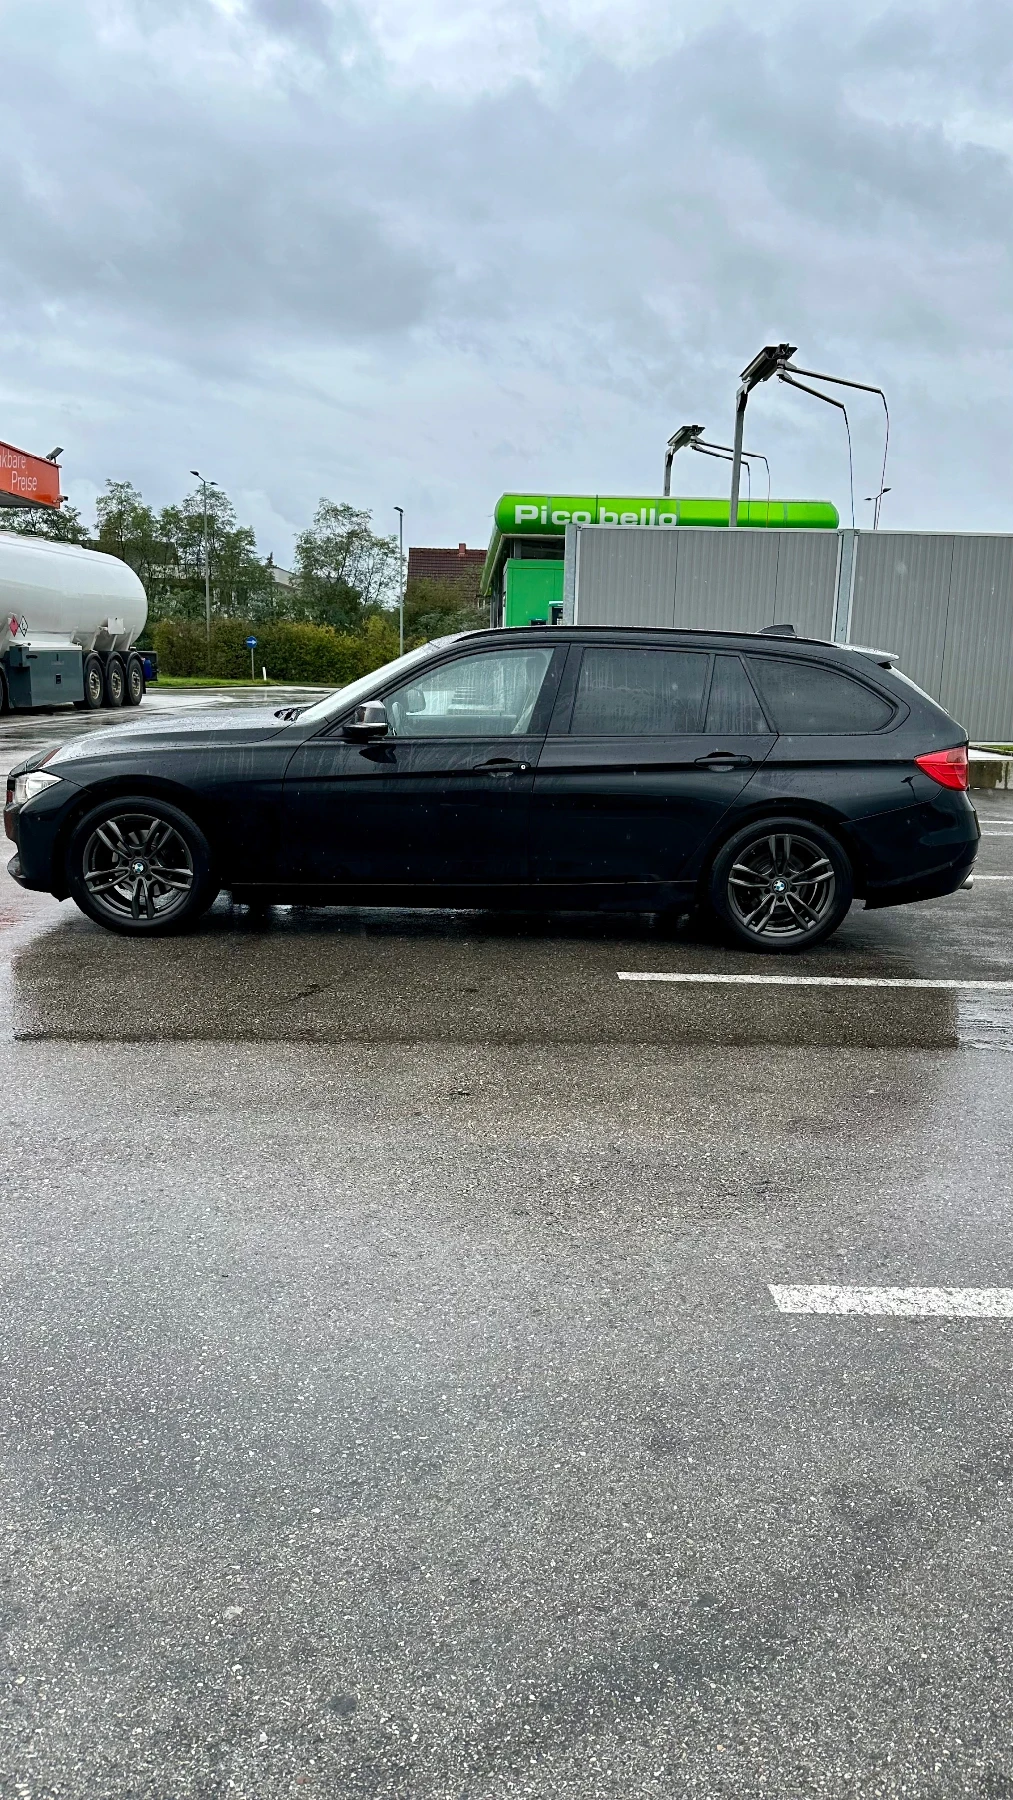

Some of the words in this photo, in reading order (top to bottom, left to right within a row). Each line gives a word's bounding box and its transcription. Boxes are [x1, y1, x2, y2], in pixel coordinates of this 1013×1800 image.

[0, 448, 26, 469] kbare
[11, 470, 38, 491] Preise
[514, 504, 592, 526] Pico
[599, 506, 678, 526] bello
